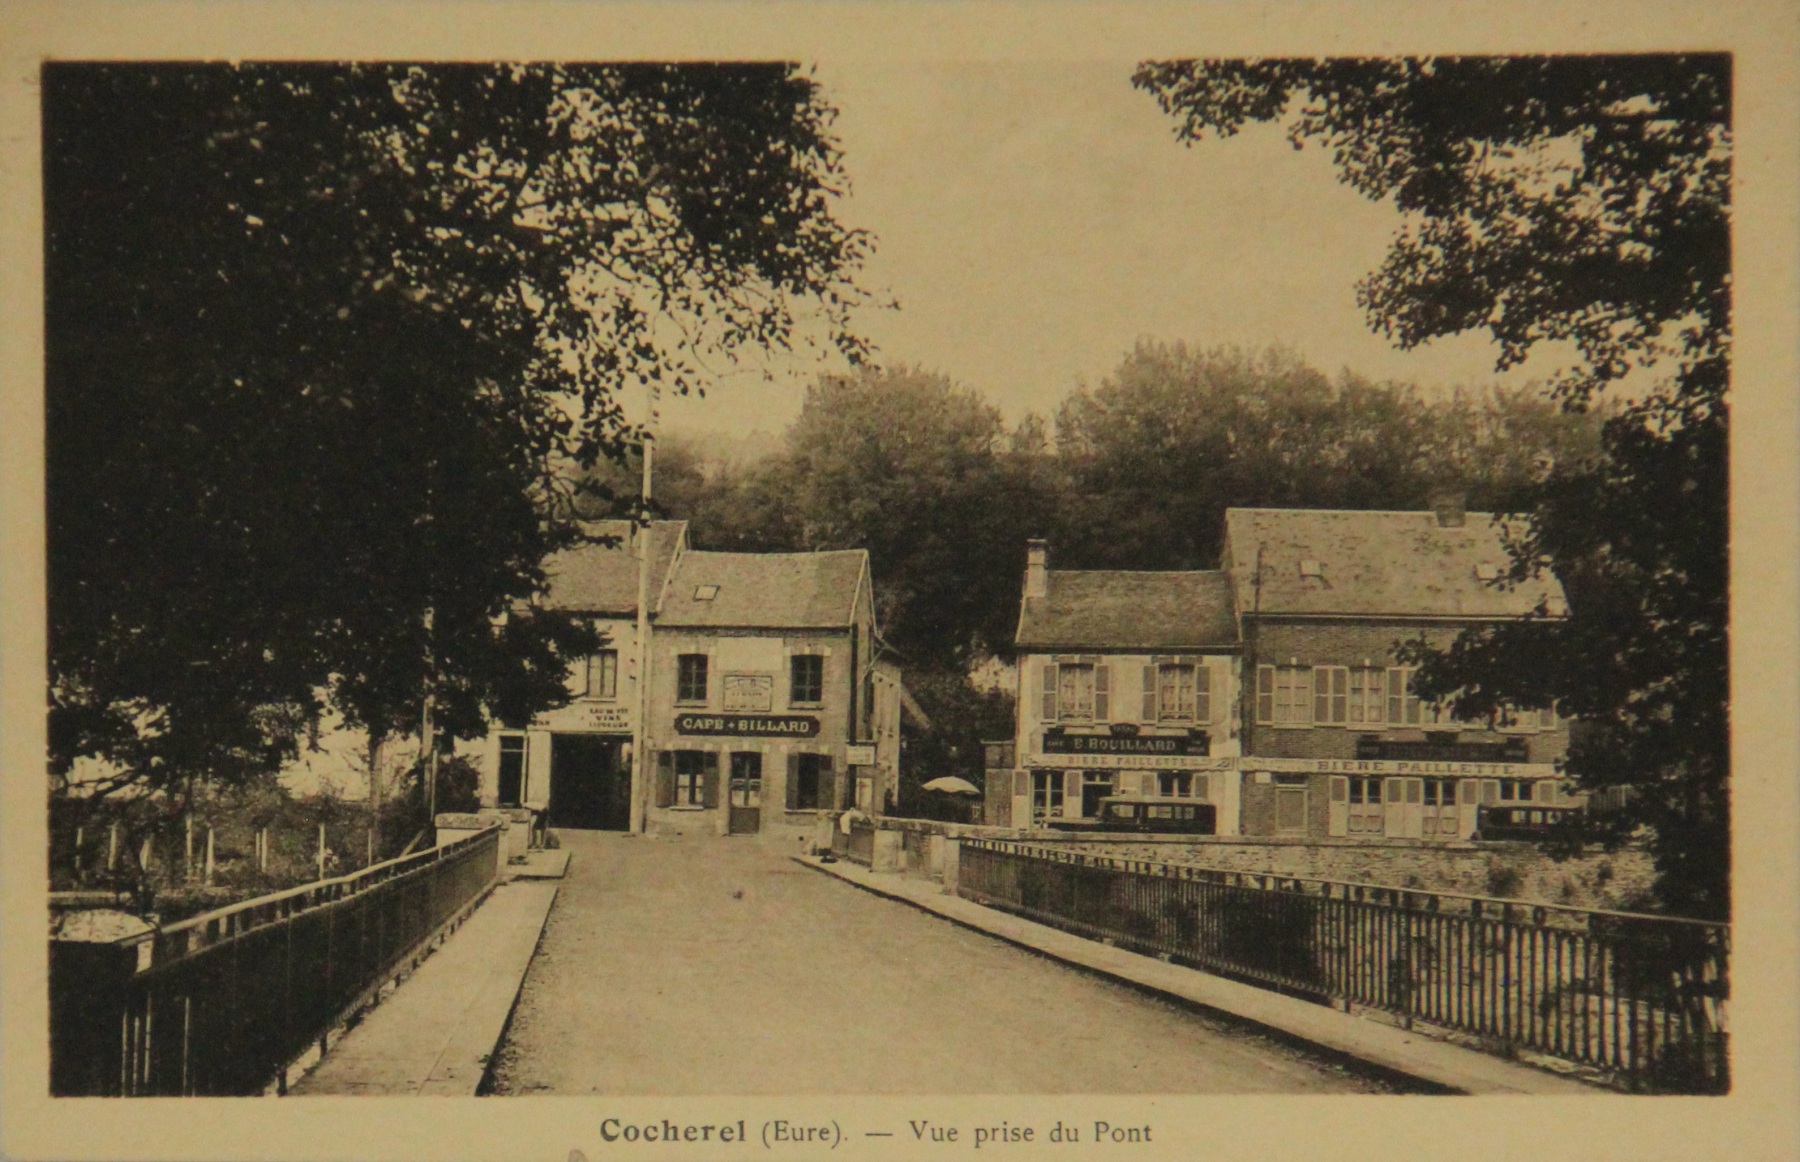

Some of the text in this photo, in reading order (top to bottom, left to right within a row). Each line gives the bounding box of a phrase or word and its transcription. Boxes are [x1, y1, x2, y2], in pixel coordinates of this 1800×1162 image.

[738, 719, 810, 733] BILLARD
[1089, 738, 1176, 751] BOUILLARD
[1116, 757, 1186, 767] PAILLETTE
[1396, 762, 1516, 775] PAILLETTE
